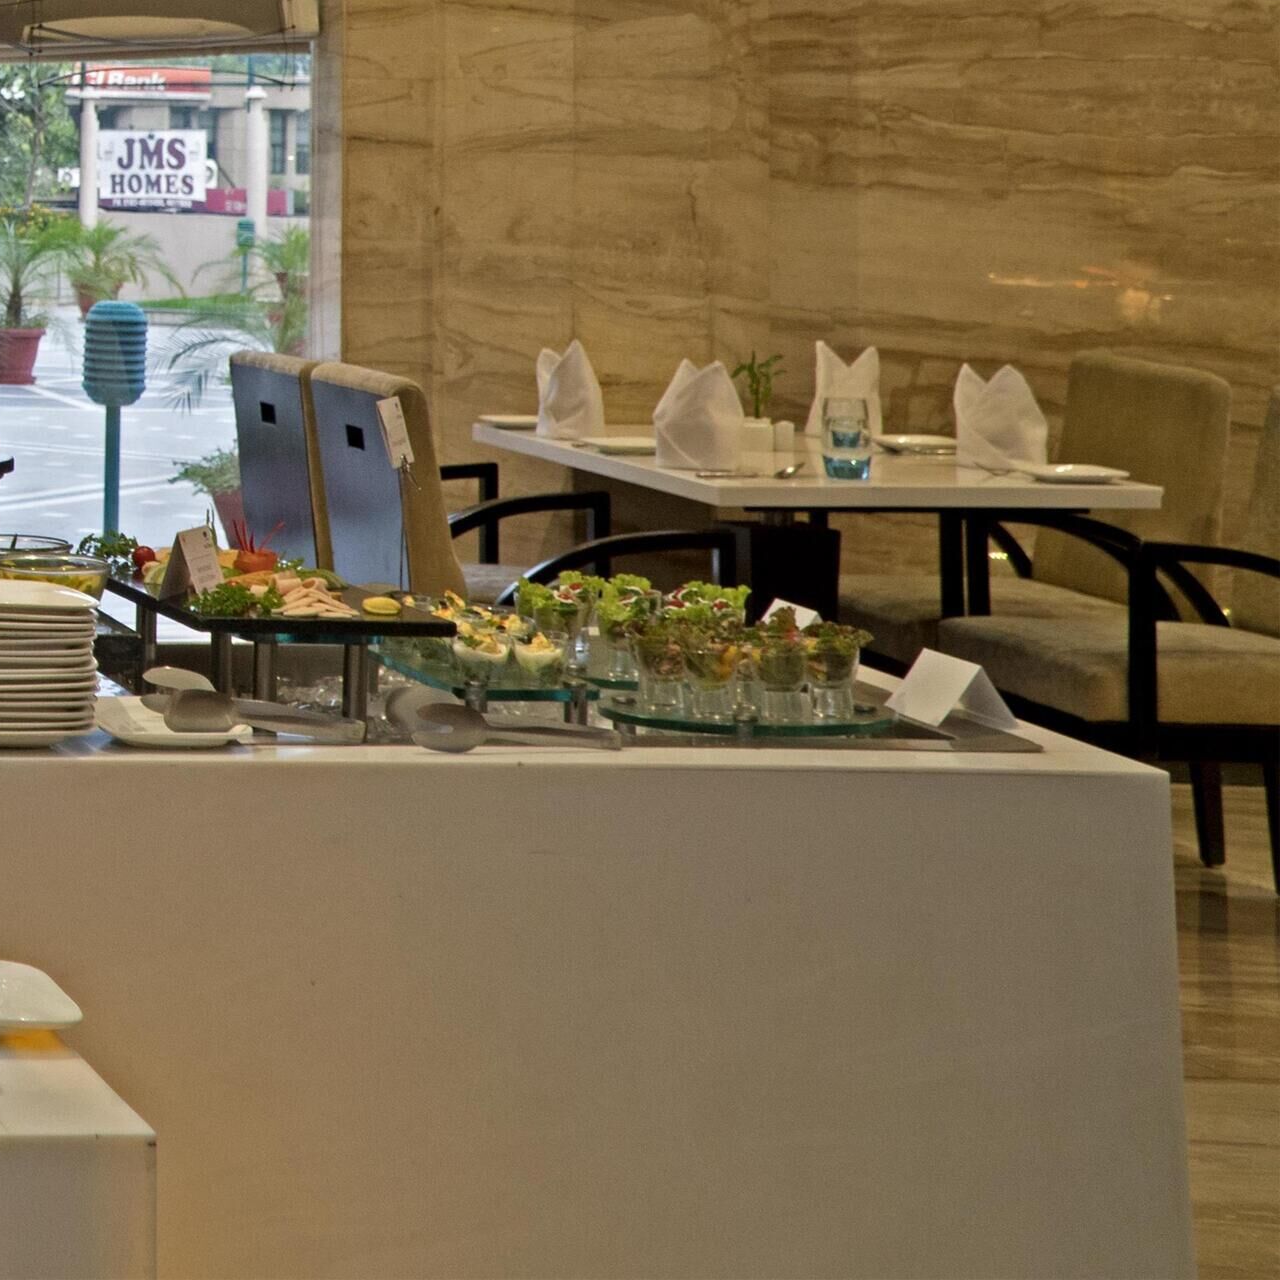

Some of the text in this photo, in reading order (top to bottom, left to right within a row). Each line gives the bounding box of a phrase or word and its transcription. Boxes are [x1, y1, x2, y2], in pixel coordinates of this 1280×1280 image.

[107, 71, 166, 91] Bank
[117, 137, 187, 171] JMS
[110, 173, 194, 196] HOMES
